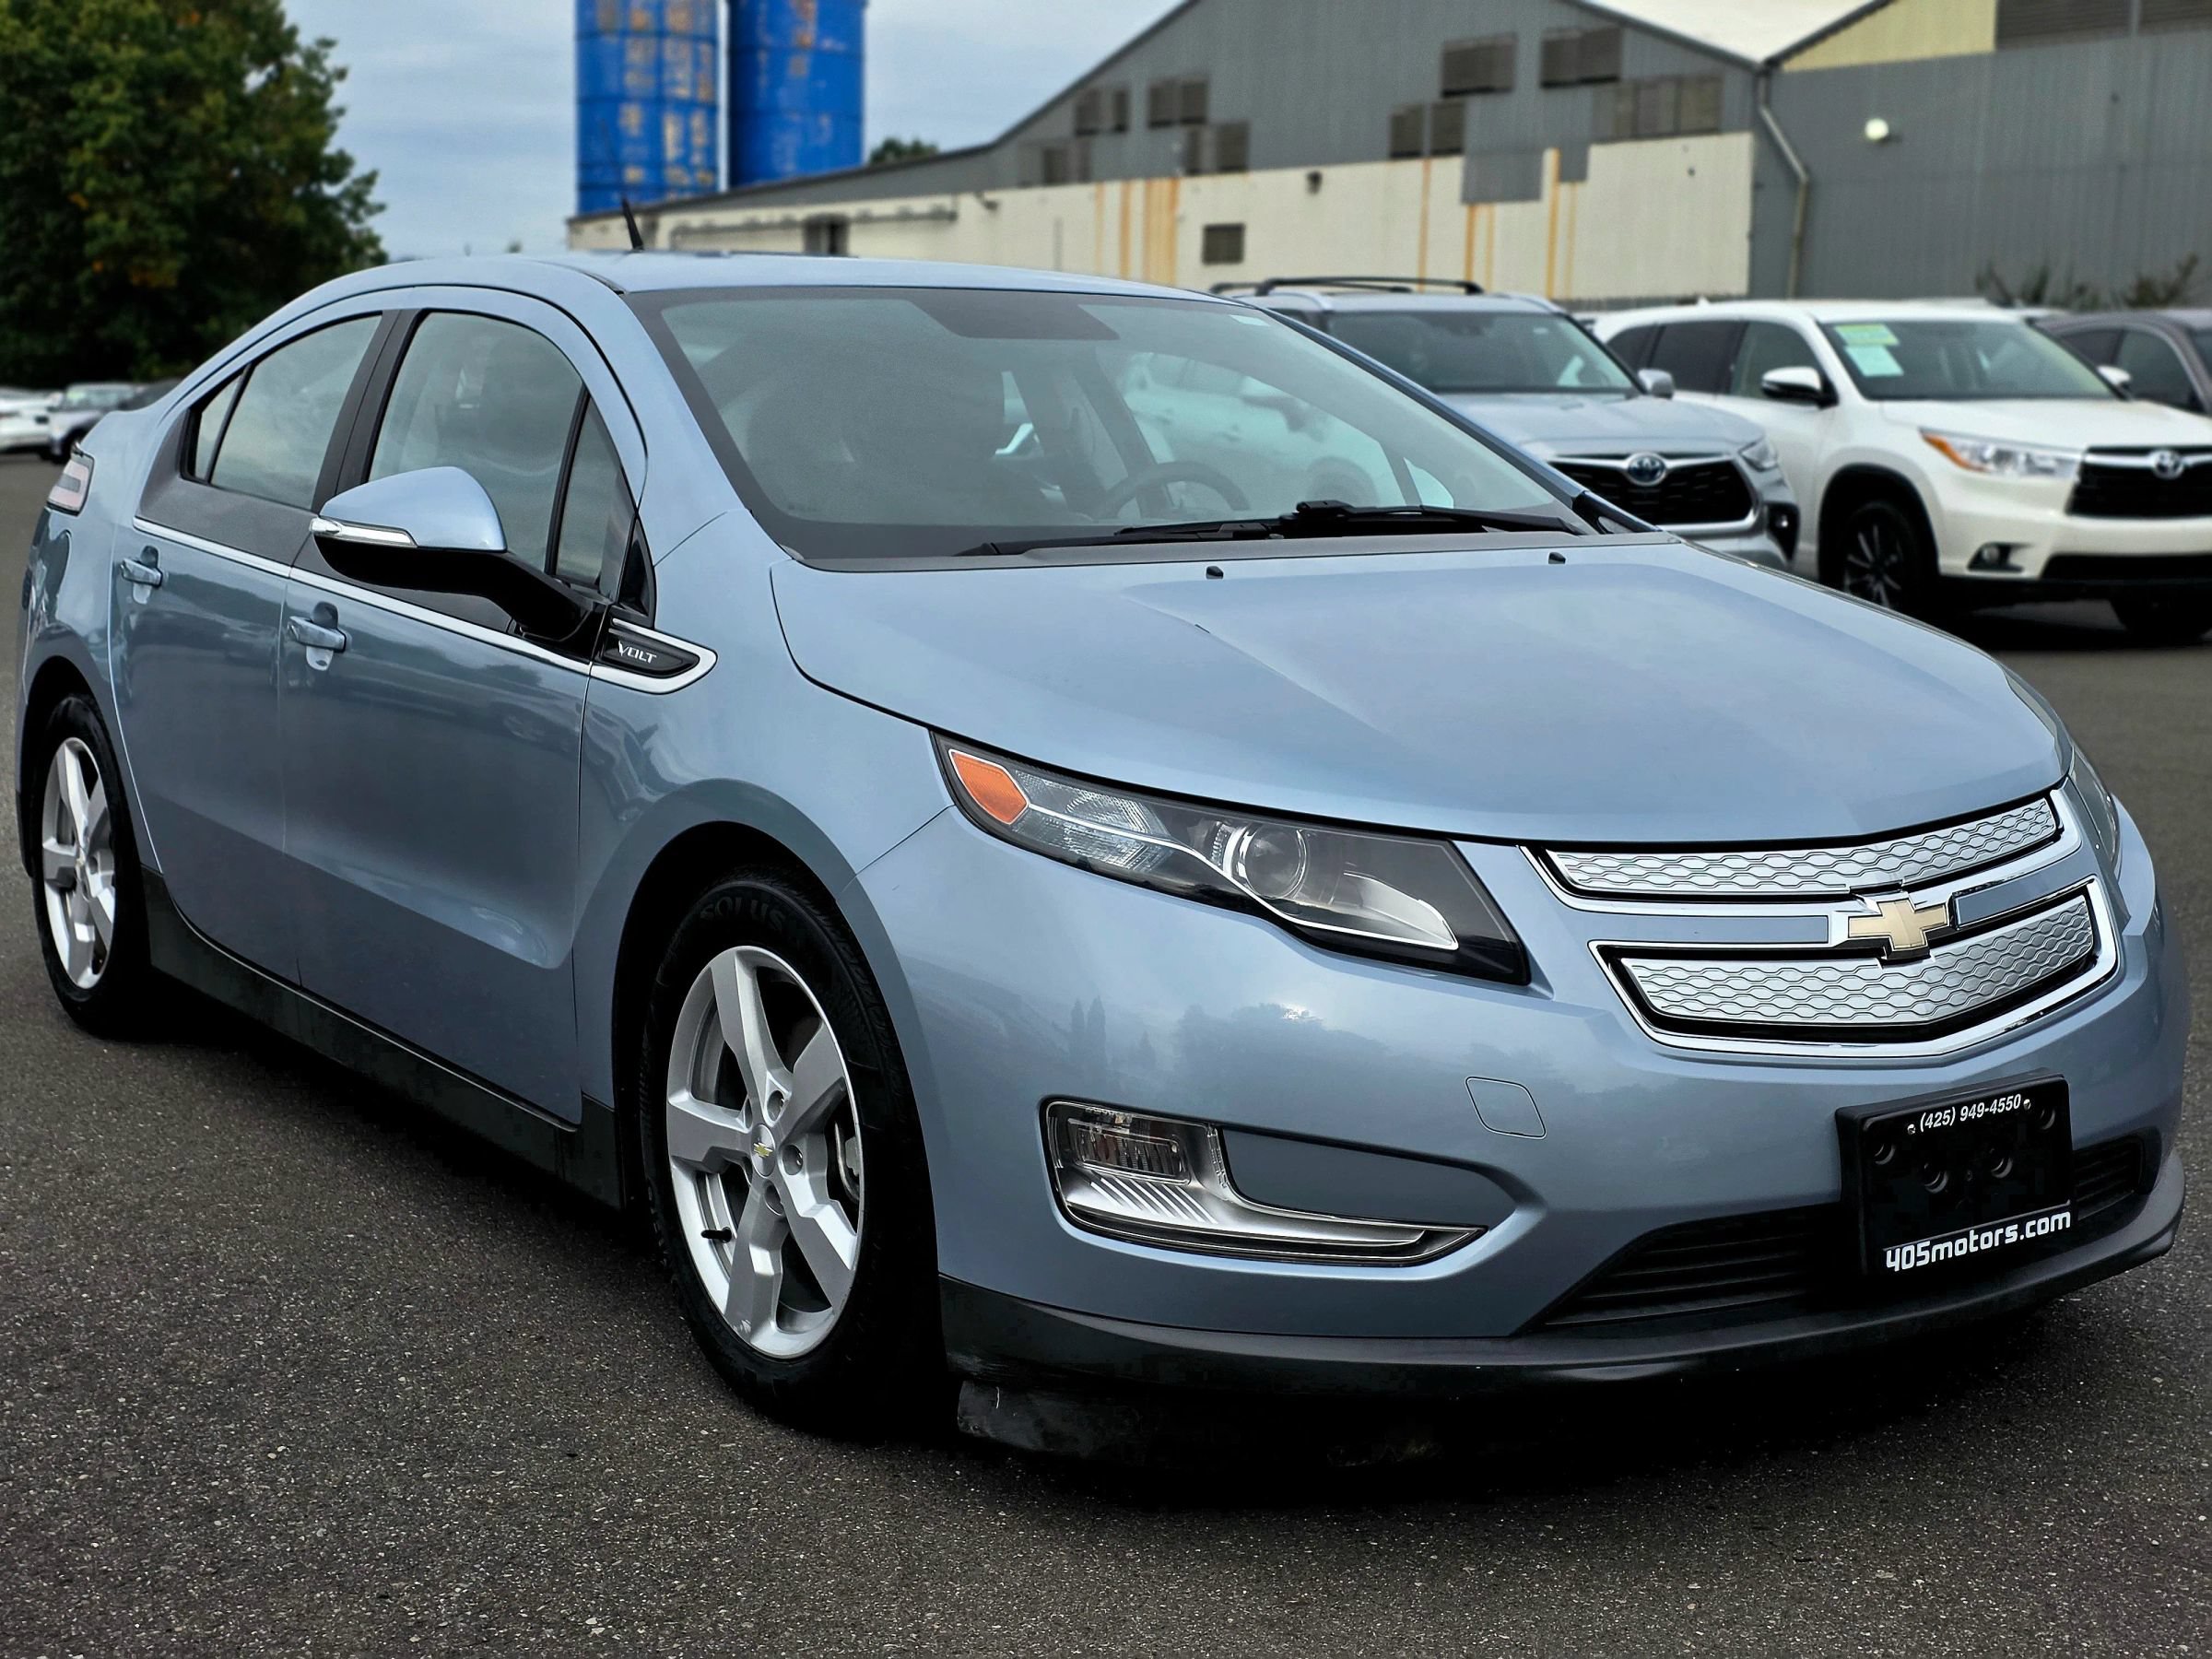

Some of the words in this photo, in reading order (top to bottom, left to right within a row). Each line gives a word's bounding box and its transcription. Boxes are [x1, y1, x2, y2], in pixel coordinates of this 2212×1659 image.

[618, 640, 657, 664] VOLT
[1920, 1107, 1956, 1132] (425)
[1959, 1094, 2021, 1122] 949-4550
[1886, 1211, 2071, 1272] 405motors.com
